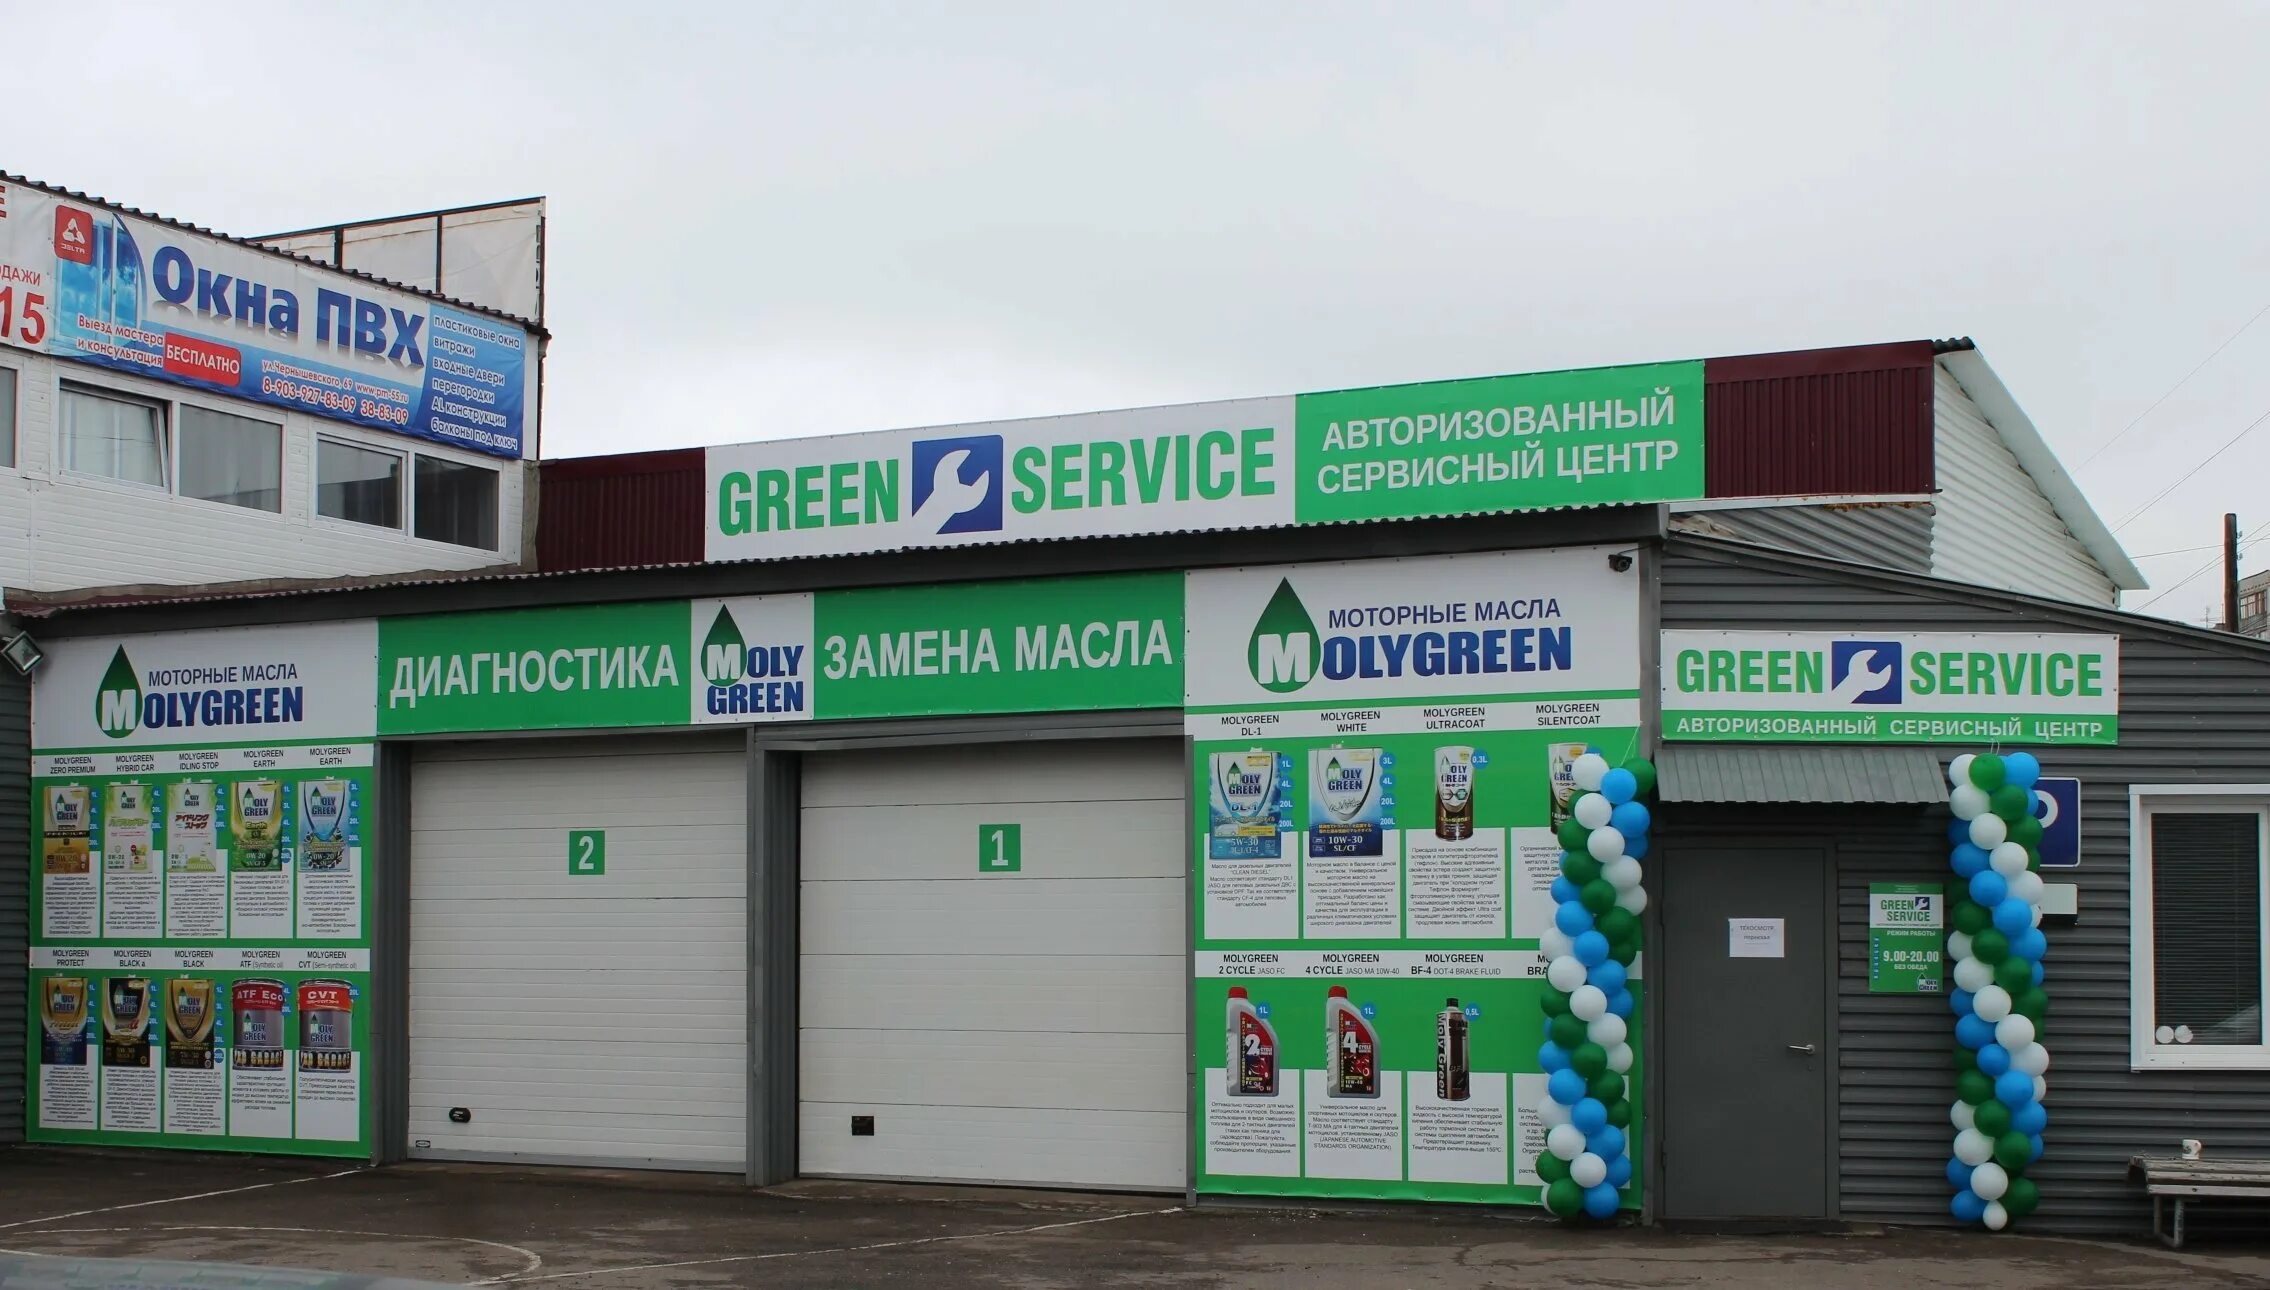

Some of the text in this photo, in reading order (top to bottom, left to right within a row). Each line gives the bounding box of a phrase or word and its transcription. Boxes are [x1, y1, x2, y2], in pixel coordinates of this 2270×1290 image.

[153, 245, 425, 367] Окна ПВХ
[78, 314, 164, 347] Выезд мастера
[434, 316, 520, 349] пластиковые окна
[77, 338, 164, 366] и консультация
[434, 337, 475, 357] витражи
[166, 345, 240, 375] БЕСПЛАТНО
[433, 358, 504, 387] входные двери
[343, 377, 353, 390] 69
[432, 378, 495, 404] перегородки
[262, 376, 409, 425] 8-903-927-83-09 38-83-09
[446, 402, 506, 427] конструкции
[1321, 386, 1675, 451] АВТОРИЗОВАННЫЙ
[431, 417, 517, 450] балконы под ключ
[1317, 440, 1678, 494] СЕРВИСНЫЙ ЦЕНТР
[718, 428, 1275, 536] GREEN SERVICE
[1328, 598, 1561, 629] МОТОРНЫЕ МАСЛА
[823, 619, 1173, 680] ЗАМЕНА МАСЛА
[1257, 626, 1571, 684] MOLYGREEN
[148, 663, 298, 687] МОТОРНЫЕ МАСЛА
[389, 644, 680, 709] ДИАГНОСТИКА
[1676, 649, 2103, 697] GREEN SERVICE
[706, 681, 804, 716] GREEN
[101, 686, 303, 731] MOLYGREEN
[1423, 707, 1485, 717] MOLYGREEN
[1535, 703, 1600, 714] MOLYGREEN
[1221, 715, 1280, 725] MOLYGREEN
[1320, 711, 1381, 721] MOLYGREEN
[1537, 715, 1601, 726] SILENTCOAT
[1336, 723, 1367, 732] WHITE
[1426, 719, 1486, 729] ULTRACOAT
[1676, 715, 2103, 739] АВТОРИЗОВАННЫЙ СЕРВИСНЫЙ ЦЕНТР
[1241, 727, 1262, 736] DL-1
[178, 752, 219, 760] MOLYGREEN
[243, 750, 284, 758] MOLYGREEN
[309, 747, 352, 756] MOLYGREEN
[54, 756, 92, 765] MOLYGREEN
[115, 754, 154, 763] MOLYGREEN
[319, 757, 343, 765] EARTH
[116, 763, 155, 772] HYBRID CAR
[179, 761, 219, 770] IDLING STOP
[253, 760, 276, 768] EARTH
[1281, 760, 1292, 768] 1L
[50, 765, 96, 774] ZERO PREMIUM
[1229, 784, 1261, 794] GREEN
[1281, 780, 1292, 788] 4L
[1328, 780, 1363, 791] GREEN
[1380, 797, 1394, 805] 20L
[1380, 817, 1395, 825] 200L
[1328, 836, 1363, 844] 10W-30
[577, 835, 595, 871] 2
[990, 830, 1009, 867] 1
[1880, 899, 1915, 910] GREEN
[1886, 911, 1931, 922] SERVICE
[52, 949, 89, 957] MOLYGREEN
[113, 950, 152, 958] MOLYGREEN
[174, 950, 214, 958] MOLYGREEN
[241, 950, 281, 958] MOLYGREEN
[307, 951, 347, 959] MOLYGREEN
[1223, 953, 1279, 963] MOLYGREEN
[1322, 953, 1380, 963] MOLYGREEN
[1425, 953, 1484, 963] MOLYGREEN
[1883, 950, 1940, 962] 9.00-20.00
[56, 959, 85, 967] PROTECT
[119, 959, 141, 967] BLACK
[183, 960, 205, 968] BLACK
[239, 960, 252, 968] ATF
[252, 961, 276, 969] (Synthetic
[298, 961, 311, 969] CVT
[1218, 966, 1224, 974] 2
[1225, 965, 1256, 974] CYCLE
[1257, 967, 1276, 975] JASO
[1305, 965, 1400, 975] 4 CYCLE JASO MA 10W-40
[1411, 966, 1501, 975] BF-4 DOT-4 BRAKE FLUID
[237, 989, 284, 1001] ATF Eco
[307, 991, 338, 999] CVT
[1259, 1006, 1268, 1014] 1L
[1364, 1007, 1374, 1015] 1L
[1244, 1033, 1260, 1056] 2
[1343, 1031, 1359, 1054] 4
